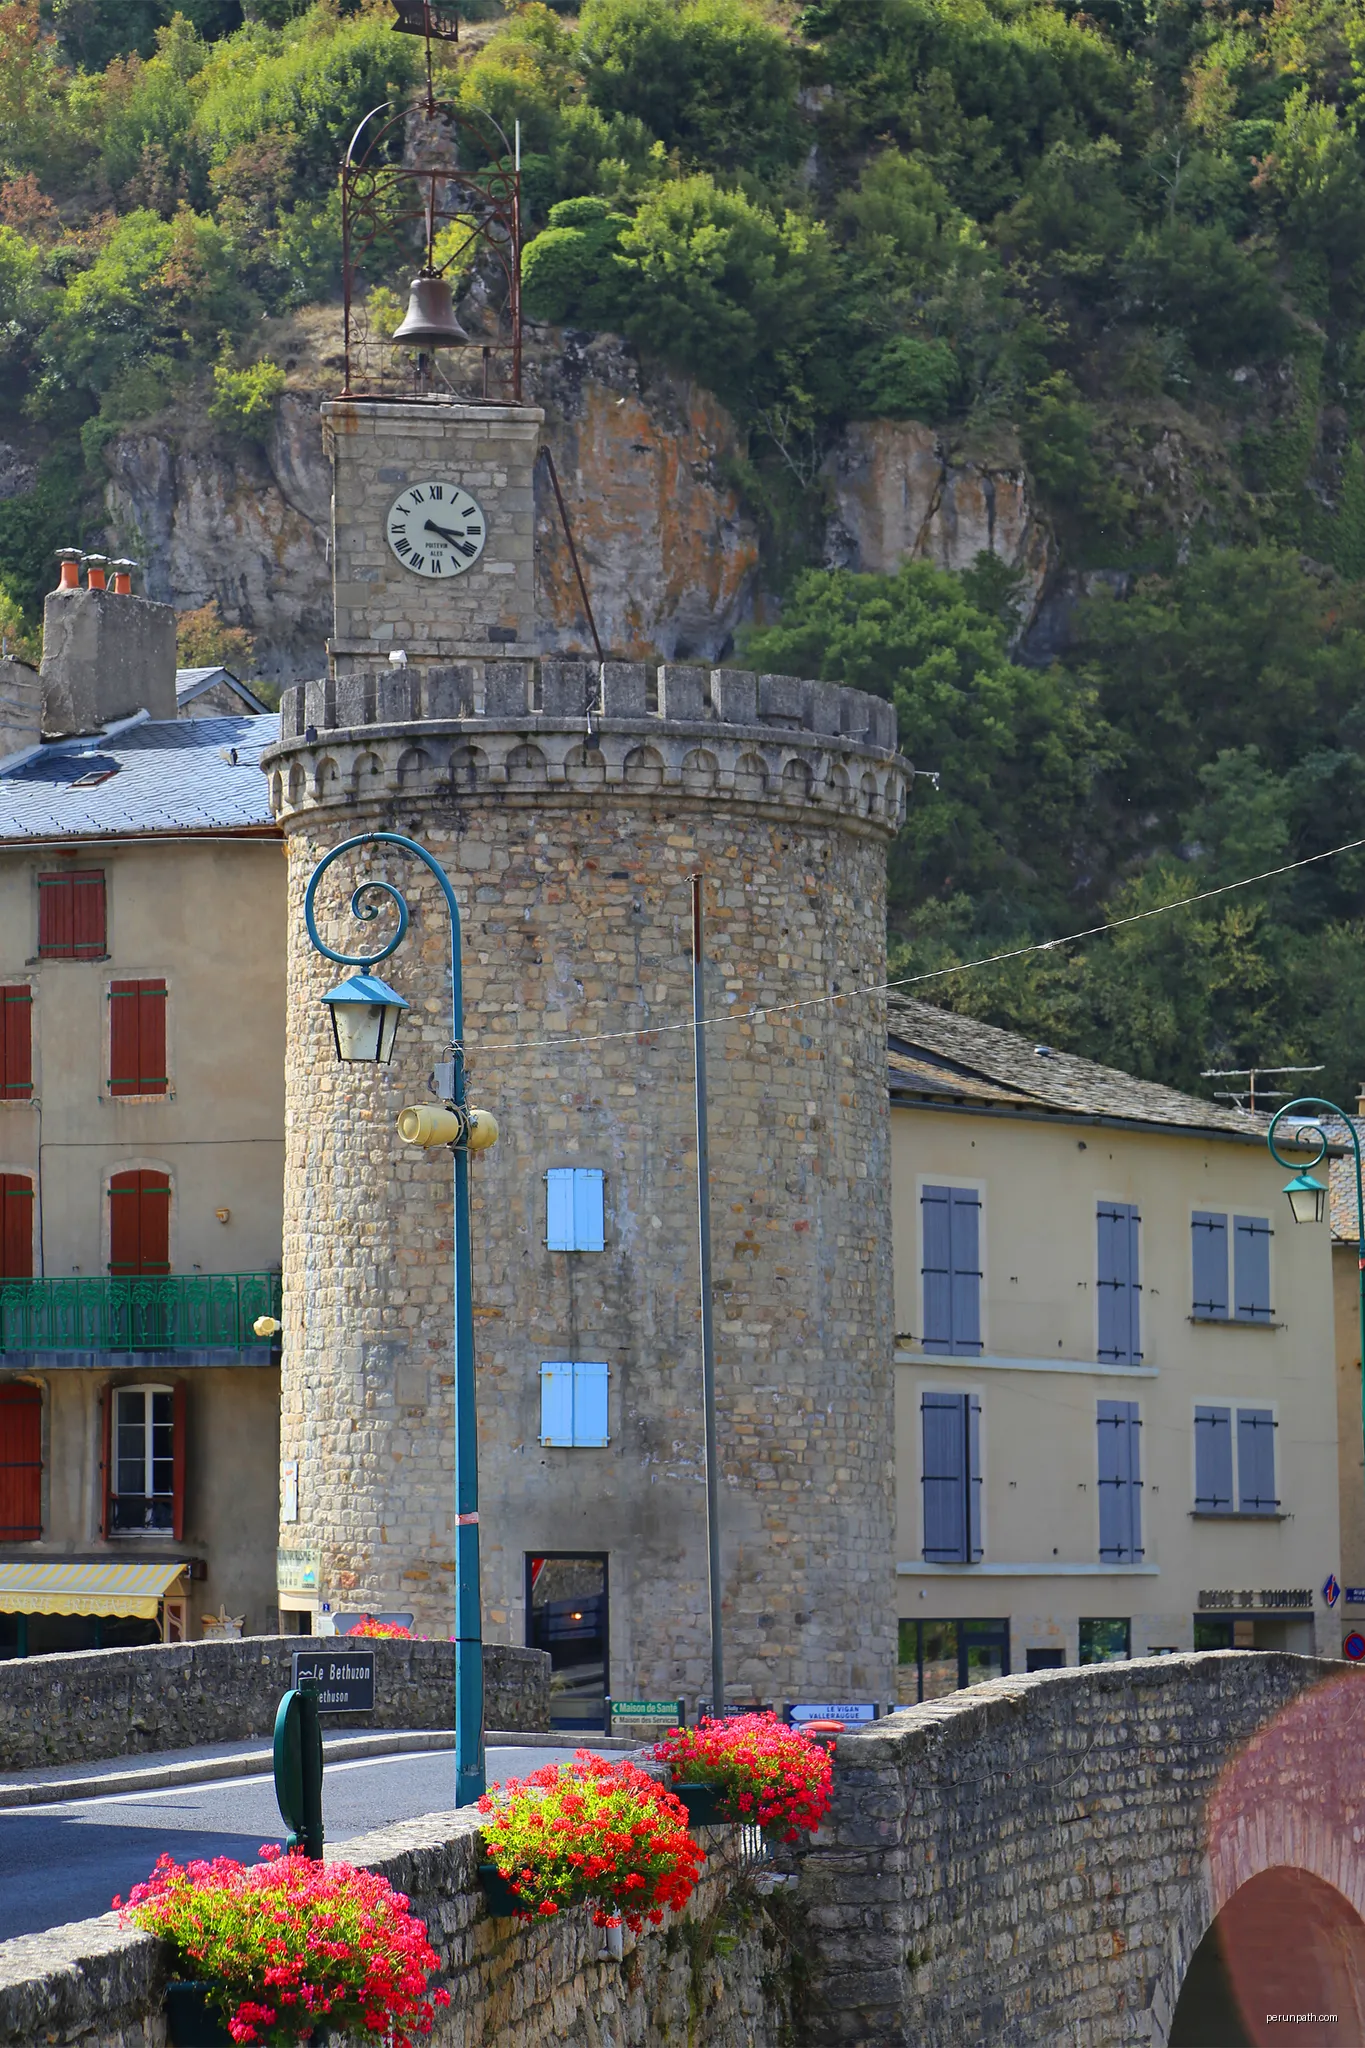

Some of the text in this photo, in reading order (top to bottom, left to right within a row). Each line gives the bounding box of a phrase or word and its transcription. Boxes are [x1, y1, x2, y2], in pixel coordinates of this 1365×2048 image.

[409, 489, 425, 505] XI
[429, 485, 442, 500] XII
[63, 1597, 143, 1613] ARTISANALE
[313, 1663, 370, 1681] Le Bethuzon
[317, 1690, 349, 1703] ethuson
[619, 1702, 678, 1713] Maison de Santé
